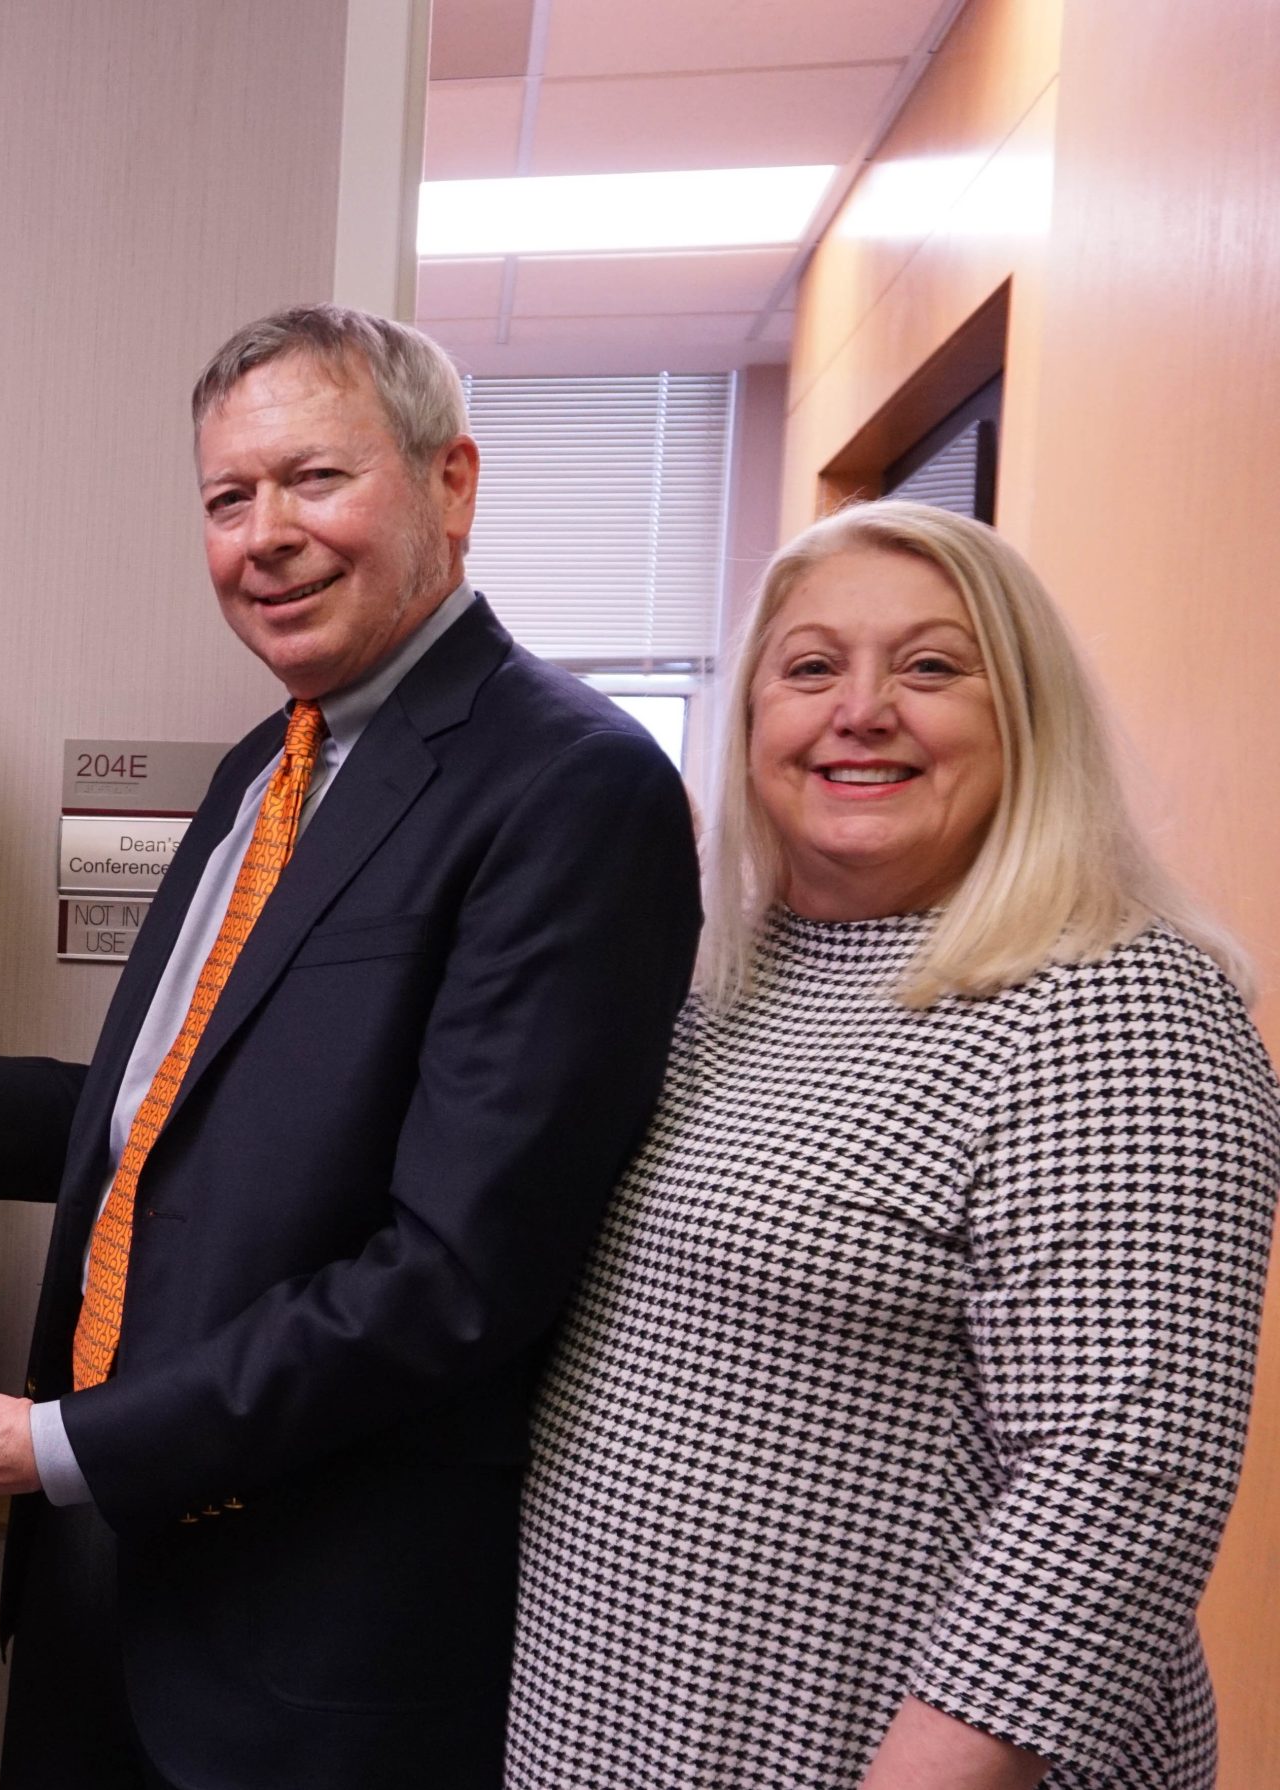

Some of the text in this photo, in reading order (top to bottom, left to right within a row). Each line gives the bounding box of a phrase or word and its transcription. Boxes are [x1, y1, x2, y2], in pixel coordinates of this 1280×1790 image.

[77, 754, 147, 778] 204E
[120, 836, 181, 852] Dean's
[70, 858, 169, 875] Conference
[75, 905, 139, 927] NOT IN
[87, 932, 125, 953] USE
